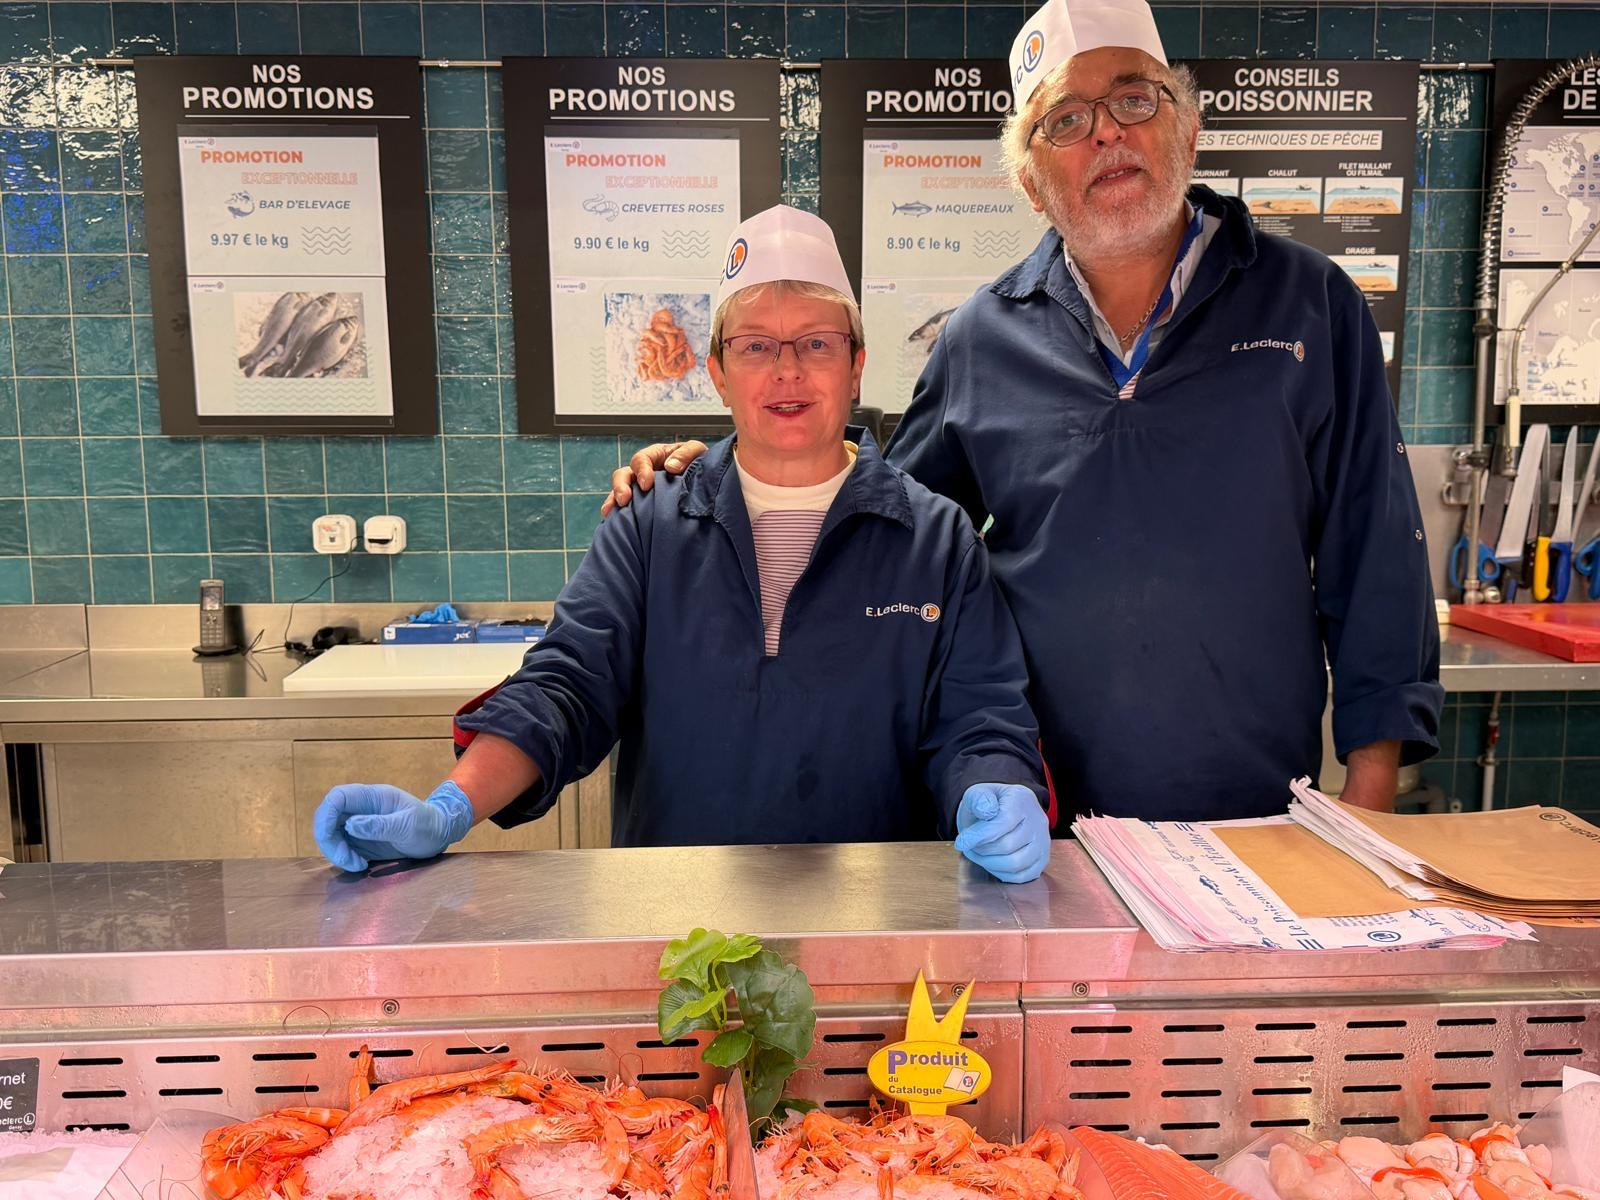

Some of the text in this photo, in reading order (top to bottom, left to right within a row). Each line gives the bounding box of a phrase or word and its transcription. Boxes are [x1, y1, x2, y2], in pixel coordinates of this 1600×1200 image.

[253, 64, 301, 84] NOS
[618, 66, 666, 86] NOS
[934, 67, 982, 87] NOS
[1234, 68, 1340, 87] CONSEILS
[182, 87, 375, 109] PROMOTIONS
[549, 89, 736, 112] PROMOTIONS
[866, 90, 1012, 113] PROMOTIO
[1200, 89, 1374, 112] POISSONNIER
[1563, 89, 1597, 110] DE
[1197, 131, 1380, 146] ES TECHNIQUES DE PÊCHE
[201, 151, 304, 164] PROMOTION
[566, 154, 667, 168] PROMOTION
[883, 155, 982, 169] PROMOTION
[1268, 169, 1298, 177] CHALUT
[1338, 162, 1393, 170] FILET MAILLANT
[1345, 169, 1357, 177] OU
[241, 172, 358, 185] EXCEPTIONNELLE
[1194, 169, 1230, 178] OURNANT
[605, 175, 719, 189] EXCEPTIONNELLE
[920, 176, 1009, 190] EXCEPTIONN
[259, 199, 351, 210] BAR D'ELEVAGE
[621, 203, 725, 214] CREVETTES ROSES
[935, 204, 1014, 214] MAQUEREAUX
[210, 233, 289, 248] 9.97 € le kg
[574, 237, 650, 252] 9.90 € le kg
[887, 237, 961, 252] 8.90 € le kg
[1345, 247, 1376, 255] DRAGUE
[1231, 338, 1293, 353] E.Leclerc
[865, 602, 920, 617] E.Leclerc
[888, 1049, 969, 1075] Produit
[888, 1075, 899, 1083] du
[888, 1085, 943, 1097] Catalogue
[0, 1116, 23, 1126] clerc
